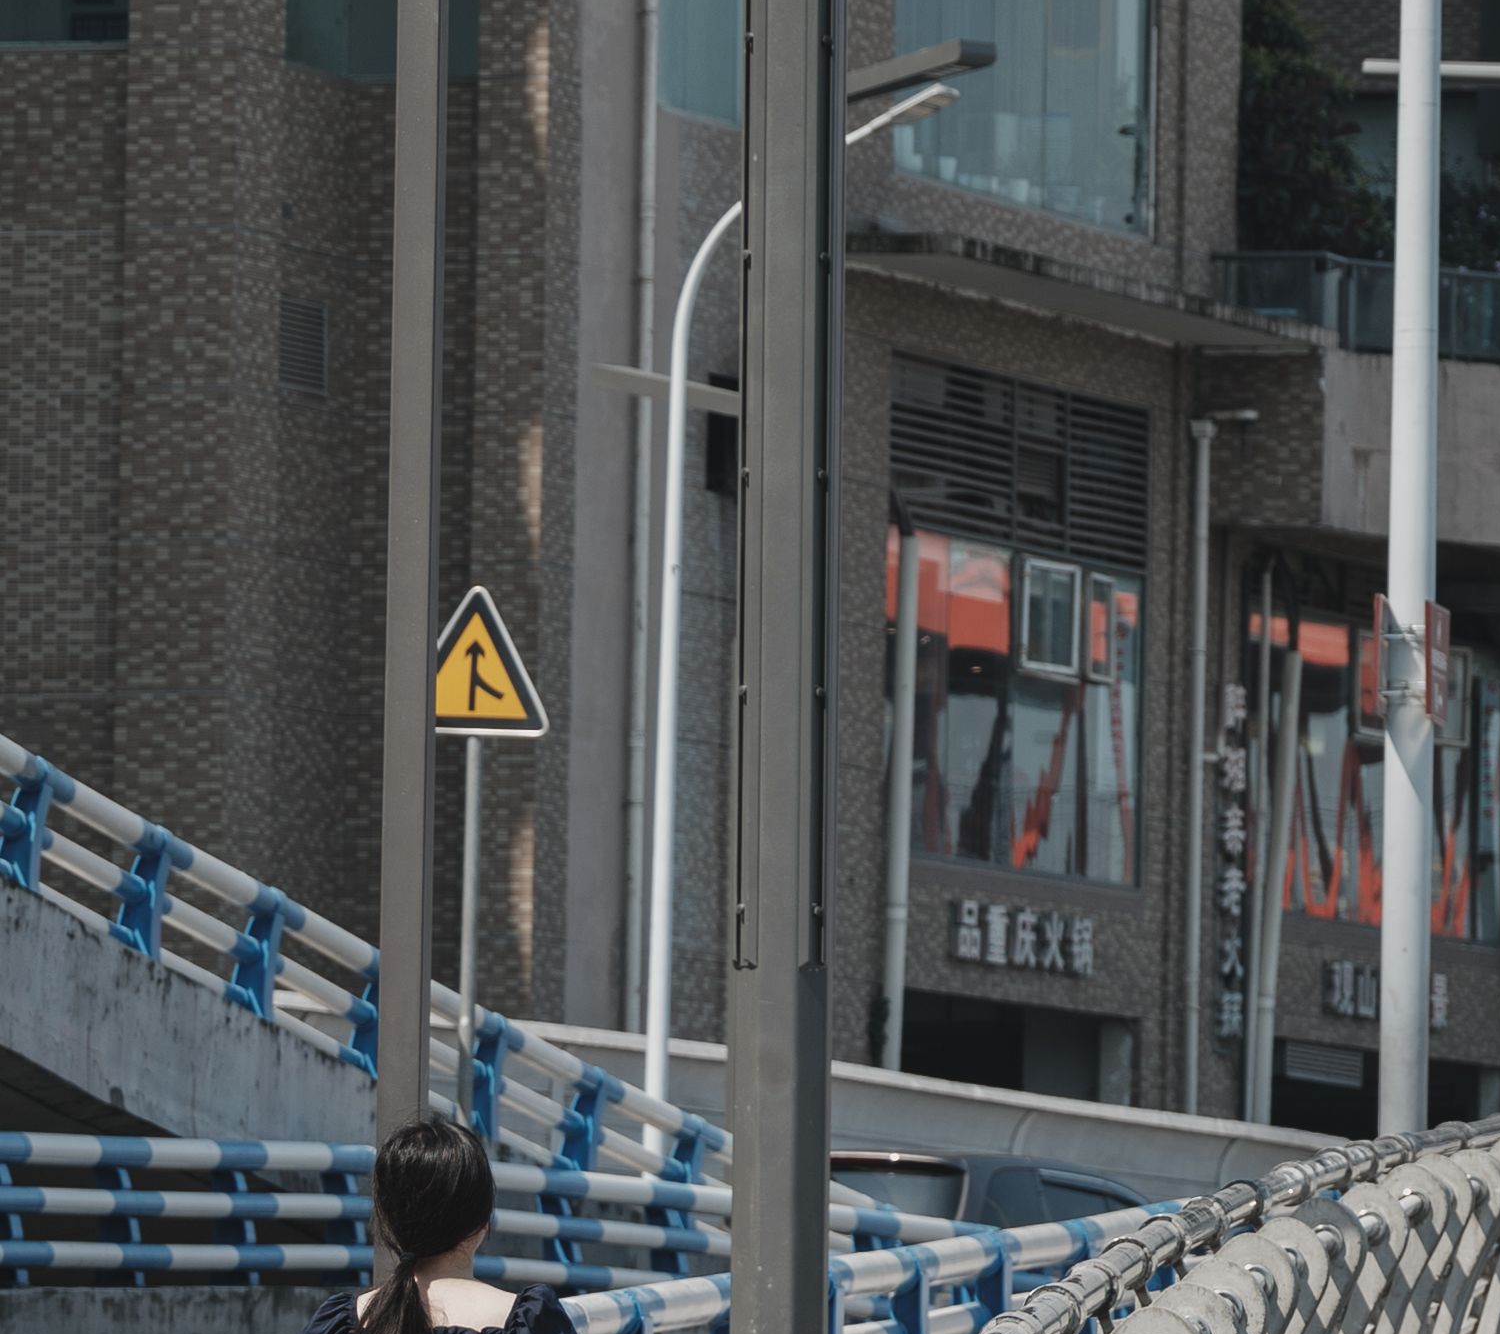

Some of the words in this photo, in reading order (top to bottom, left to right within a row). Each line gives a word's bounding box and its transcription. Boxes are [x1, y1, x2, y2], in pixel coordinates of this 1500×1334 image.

[957, 898, 1094, 977] 品重庆火锅
